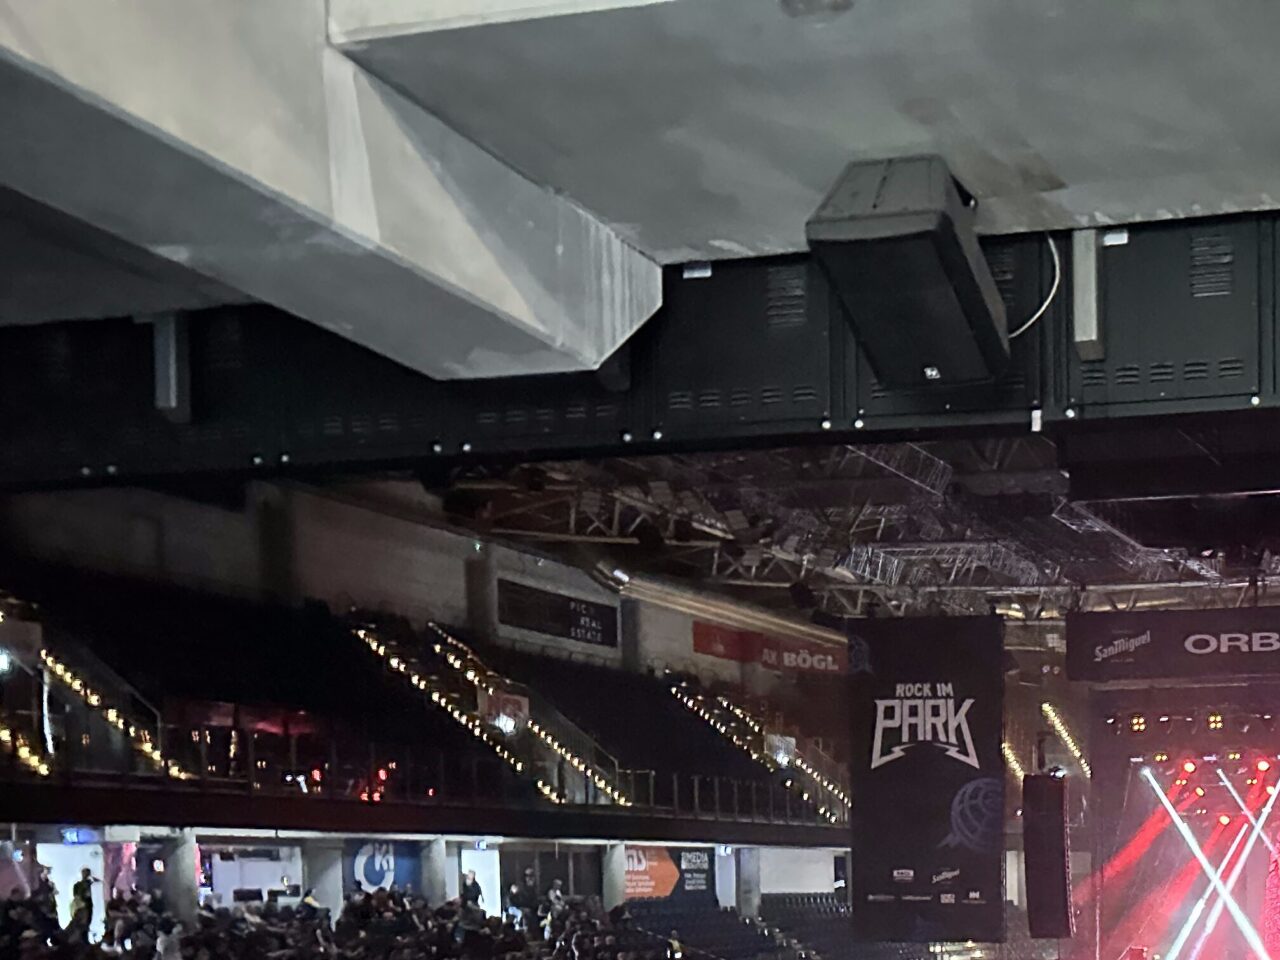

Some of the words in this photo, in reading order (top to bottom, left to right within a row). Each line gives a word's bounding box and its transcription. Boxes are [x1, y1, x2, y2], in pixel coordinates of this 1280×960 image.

[782, 649, 840, 671] BÖGL
[895, 682, 932, 698] ROCK
[936, 682, 954, 697] IM
[870, 698, 980, 769] PARK
